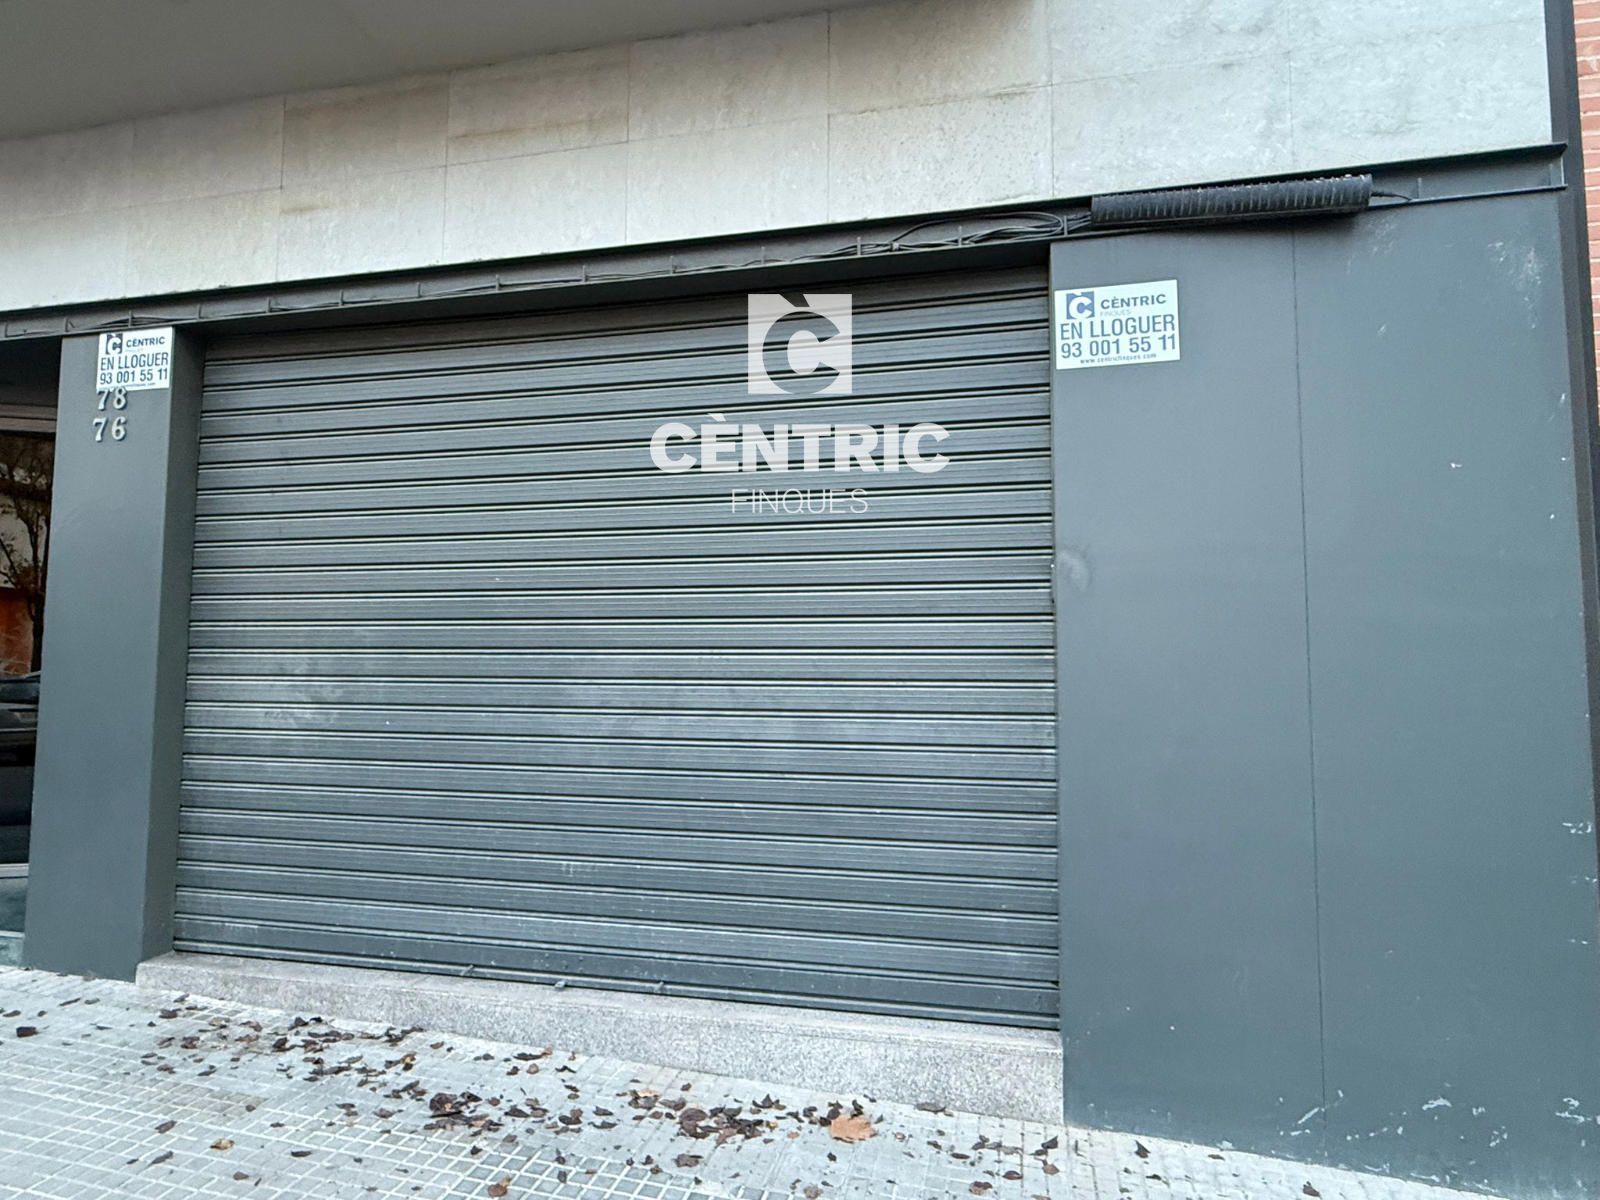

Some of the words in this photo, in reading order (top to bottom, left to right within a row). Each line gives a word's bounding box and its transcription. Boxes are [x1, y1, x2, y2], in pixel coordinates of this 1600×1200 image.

[1100, 294, 1167, 310] CÈNTRIC
[1060, 321, 1083, 341] EN
[1090, 314, 1176, 338] LLOGUER
[1061, 342, 1083, 359] 93
[1089, 338, 1121, 357] 001
[1129, 336, 1152, 353] 55
[1158, 333, 1176, 351] 11
[101, 357, 115, 371] EN
[118, 352, 169, 370] LLOGUER
[100, 372, 113, 385] 93
[116, 370, 136, 384] 001
[139, 368, 154, 382] 55
[158, 367, 168, 381] 11
[97, 387, 127, 411] 78
[93, 416, 127, 442] 76
